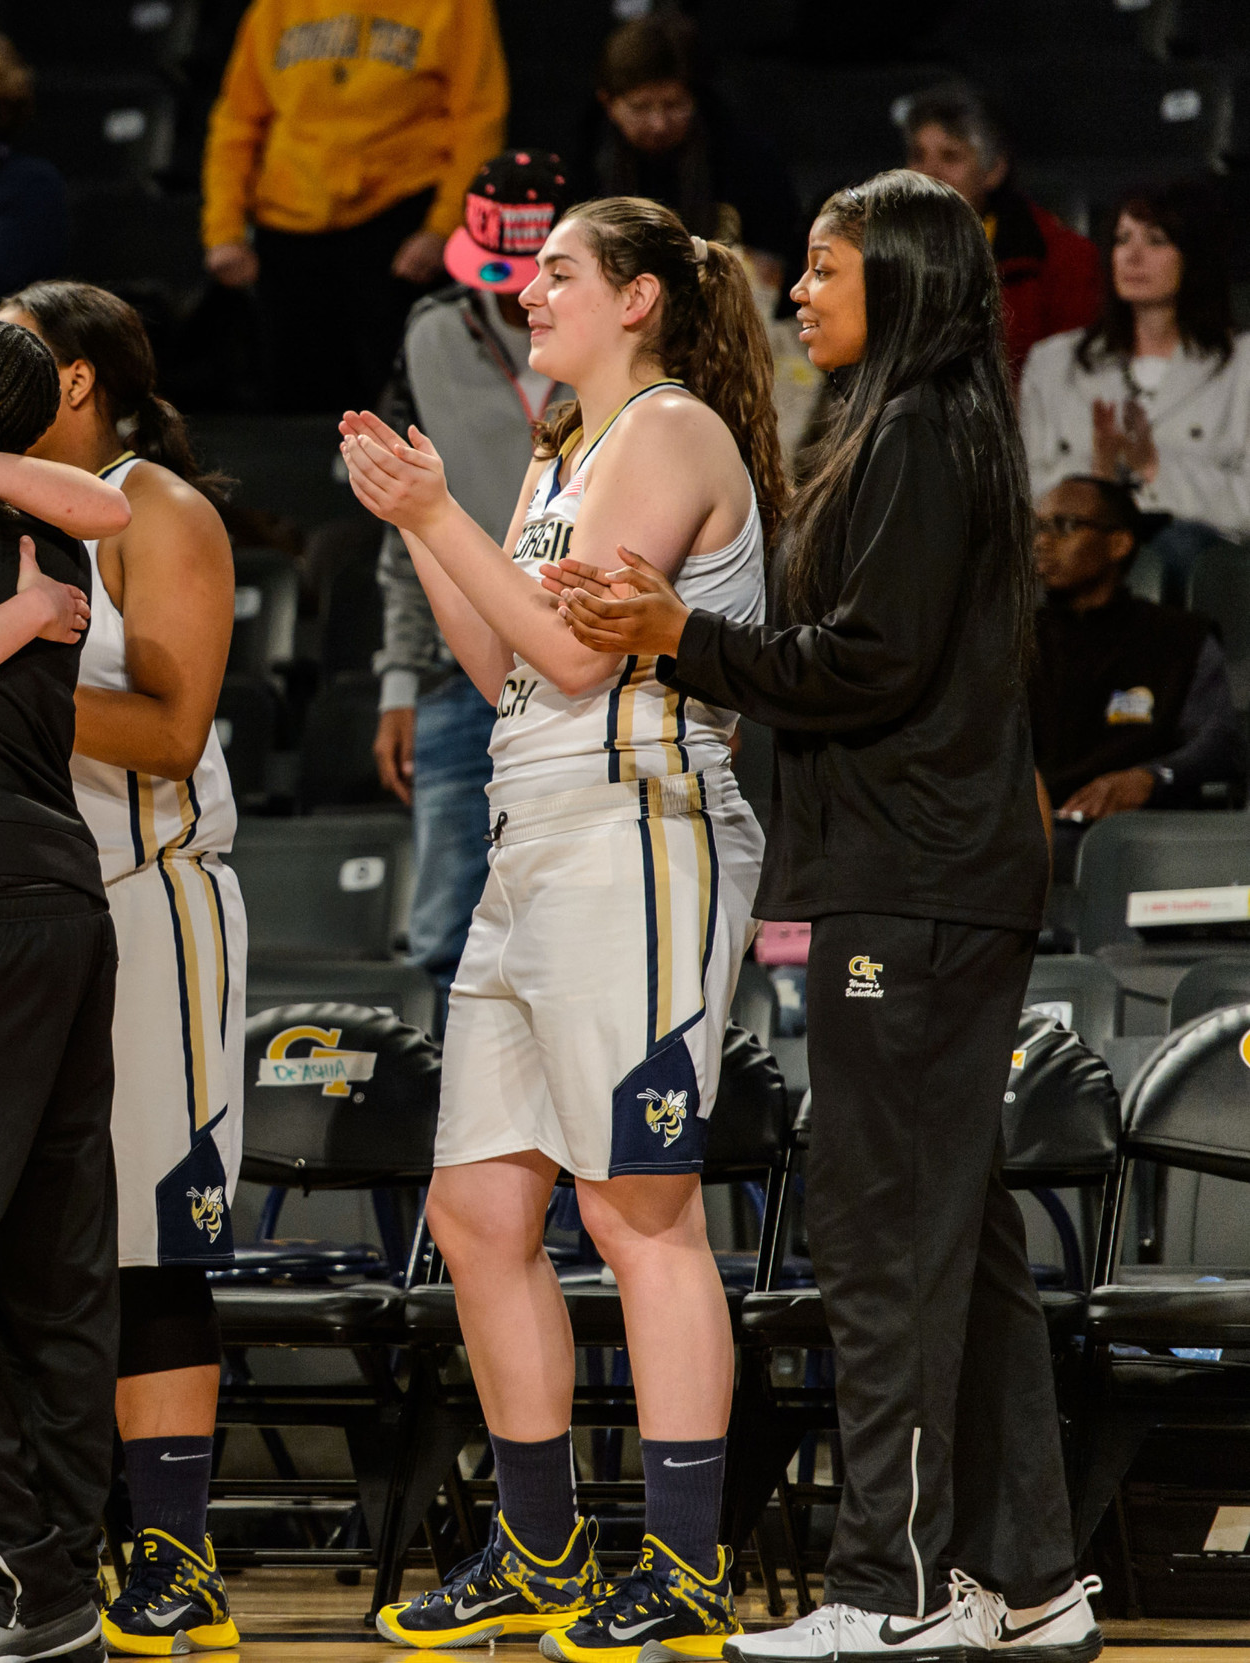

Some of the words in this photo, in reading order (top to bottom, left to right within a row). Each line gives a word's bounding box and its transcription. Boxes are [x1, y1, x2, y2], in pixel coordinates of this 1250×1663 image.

[496, 679, 538, 718] CH
[848, 955, 884, 980] GT
[844, 987, 885, 998] Basketball
